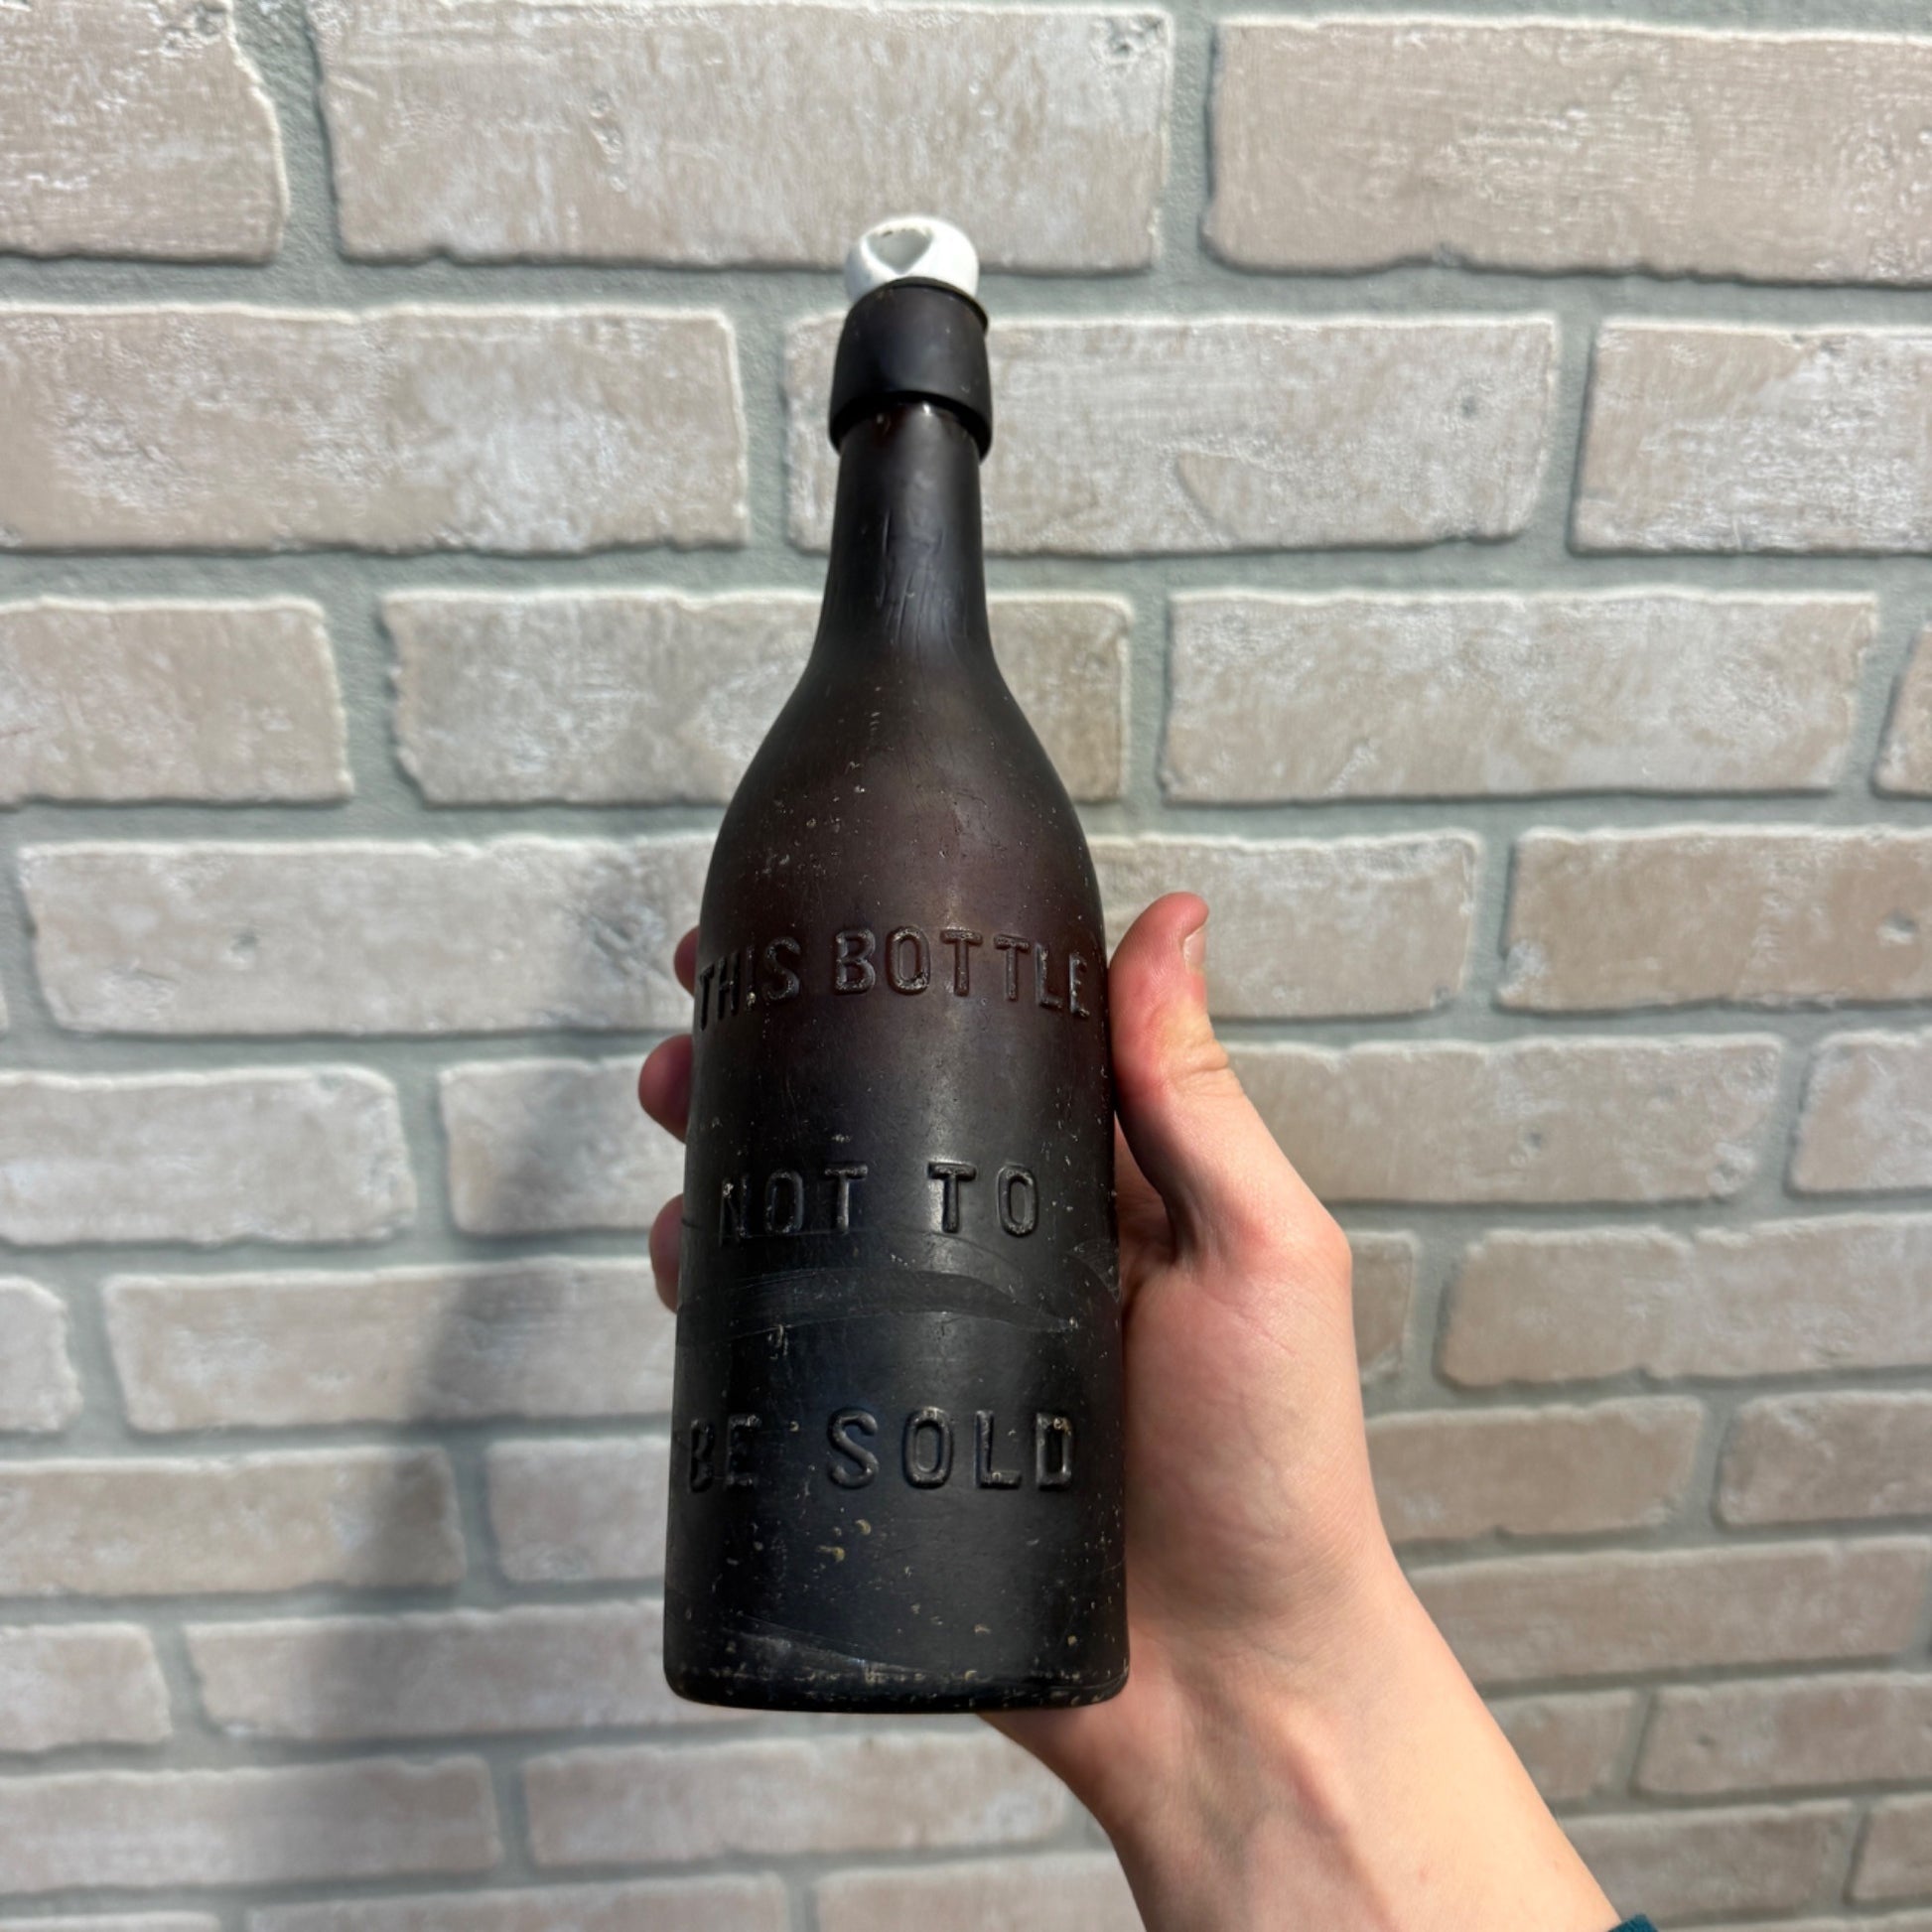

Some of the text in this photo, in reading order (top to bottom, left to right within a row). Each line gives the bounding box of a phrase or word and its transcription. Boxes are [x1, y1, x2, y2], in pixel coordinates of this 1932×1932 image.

[698, 925, 1091, 1032] THIS BOTTLE
[719, 1161, 1039, 1245] NOT TO
[688, 1405, 1077, 1494] BE SOLD
